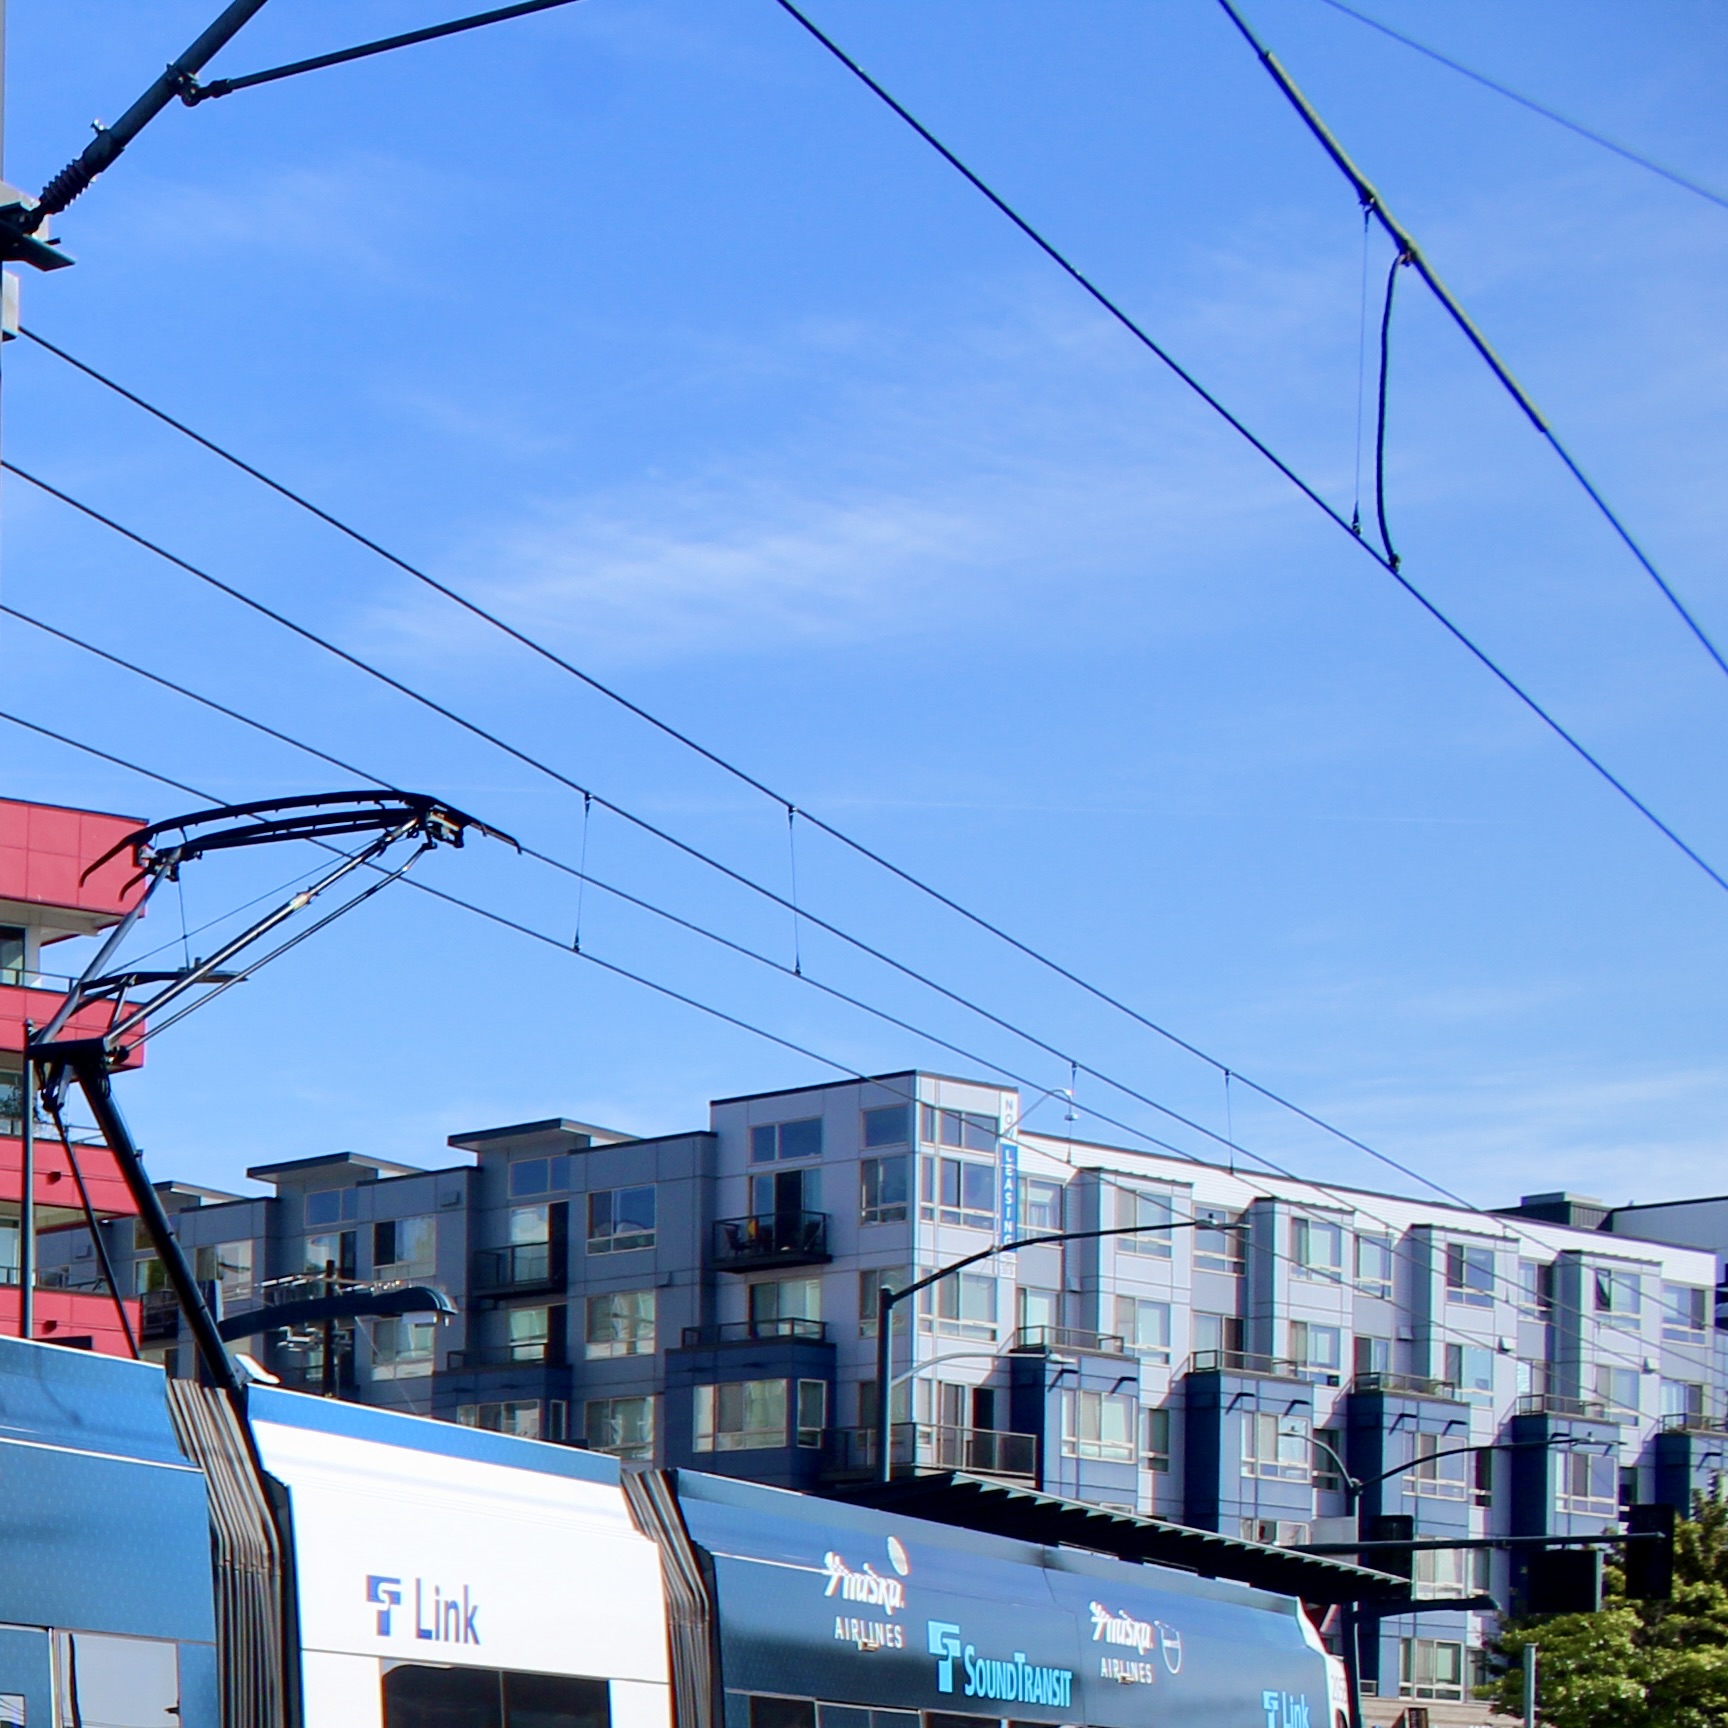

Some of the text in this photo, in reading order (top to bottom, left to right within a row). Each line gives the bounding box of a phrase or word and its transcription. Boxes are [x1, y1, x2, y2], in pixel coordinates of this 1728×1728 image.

[414, 1577, 481, 1646] Link
[834, 1616, 904, 1650] AIRLINES
[1100, 1656, 1153, 1685] AIRLINES
